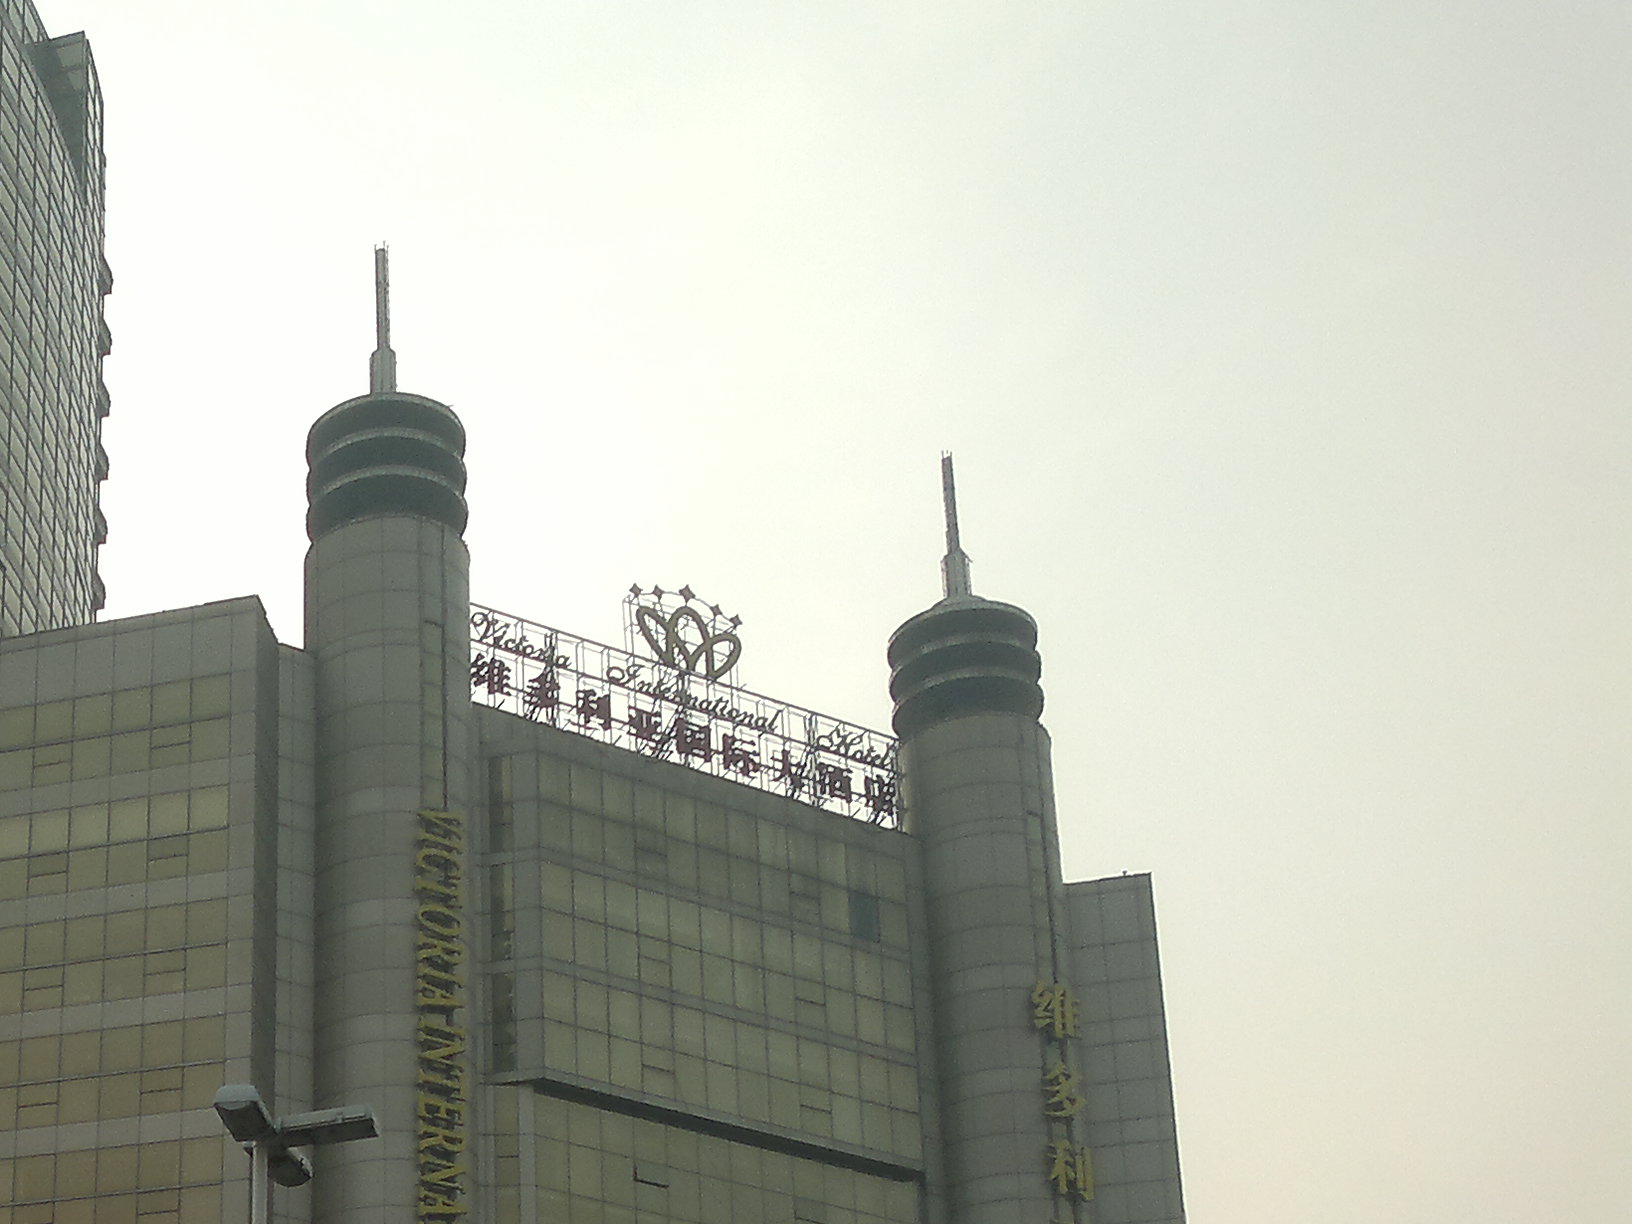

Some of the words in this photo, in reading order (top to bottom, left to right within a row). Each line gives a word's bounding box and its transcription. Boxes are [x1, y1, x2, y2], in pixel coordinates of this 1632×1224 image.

[471, 611, 572, 668] Victoria
[607, 664, 784, 740] International
[417, 809, 467, 1008] VICTORIA
